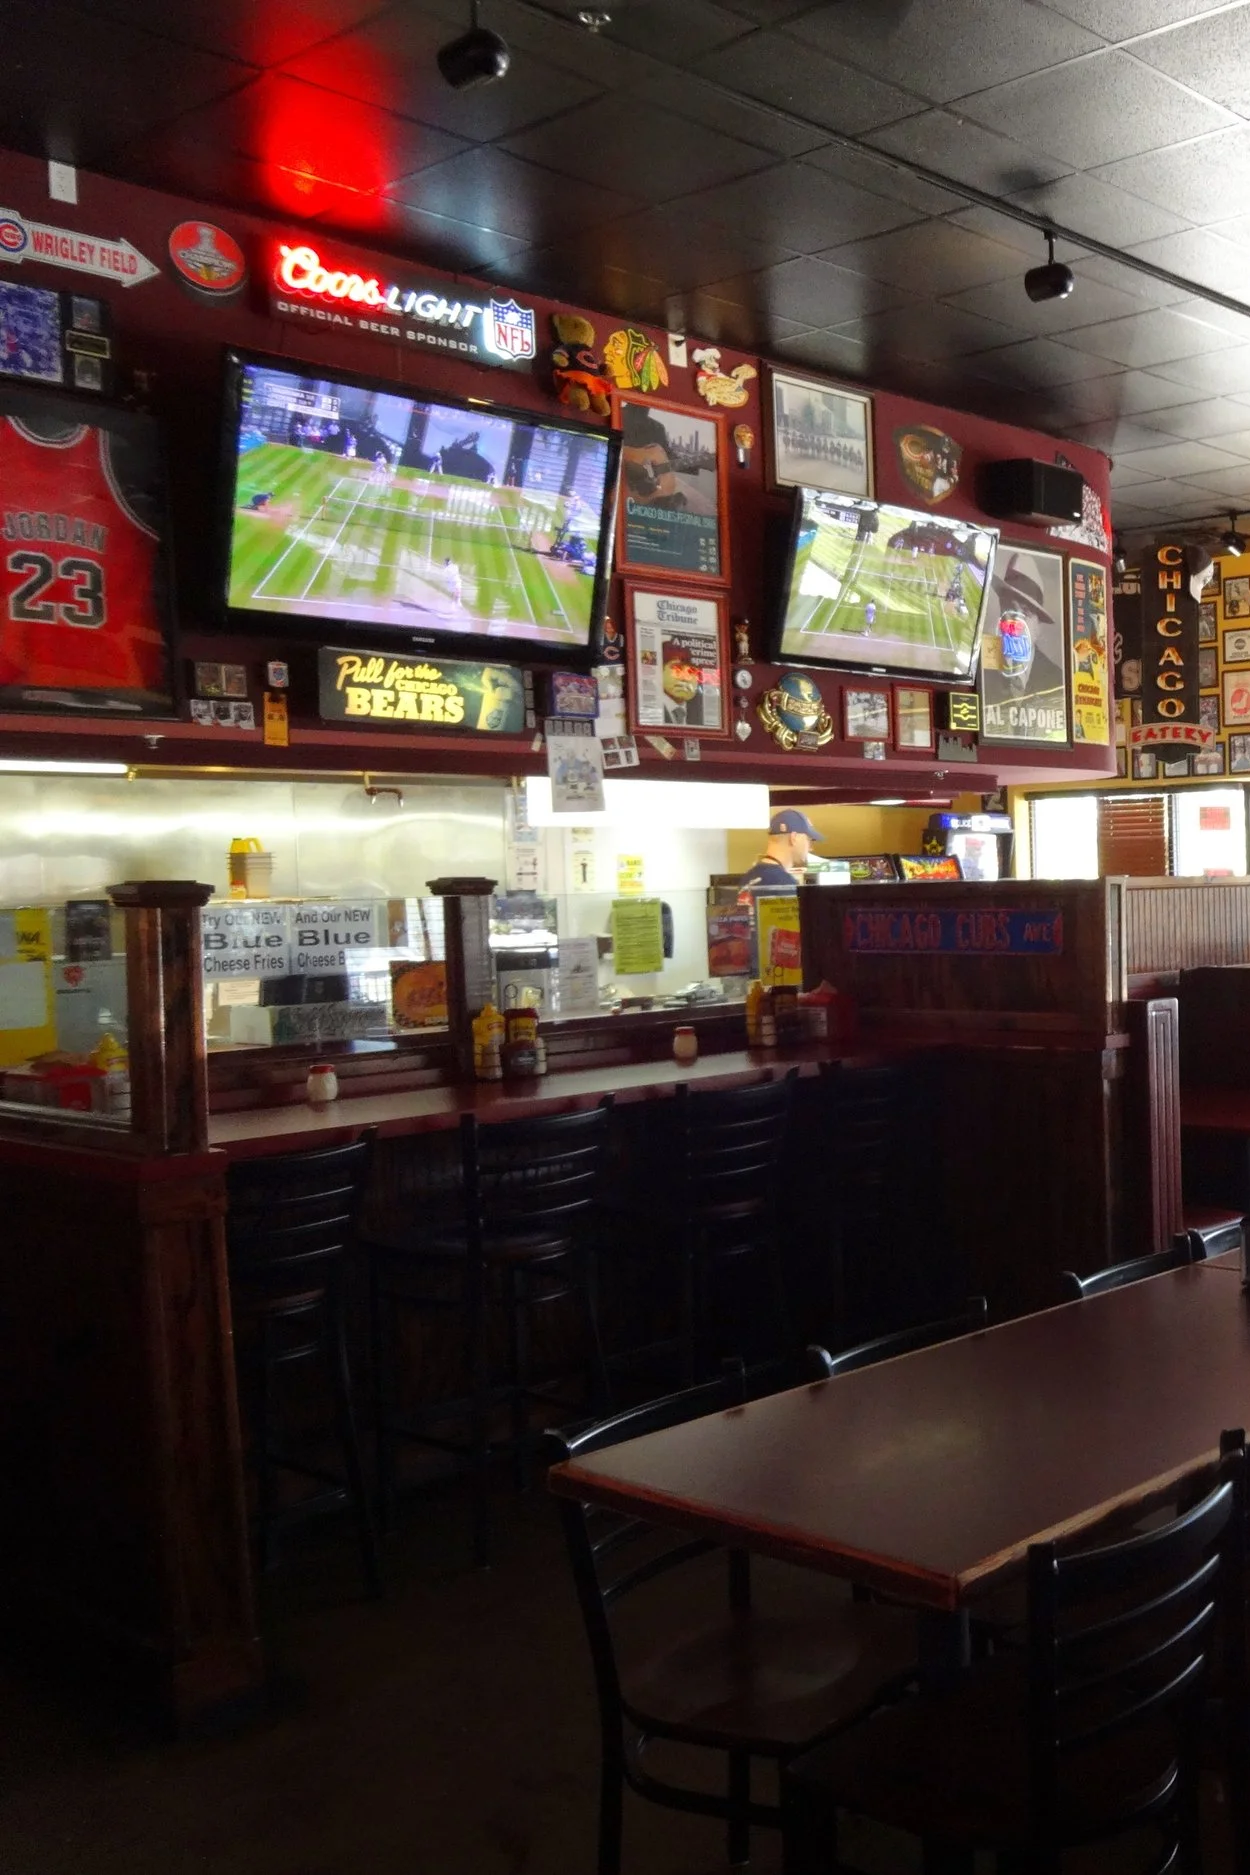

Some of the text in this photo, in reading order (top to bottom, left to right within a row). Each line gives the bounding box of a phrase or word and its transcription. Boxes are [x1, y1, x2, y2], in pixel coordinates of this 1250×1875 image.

[31, 231, 138, 275] WRIGLEY FIELD
[279, 245, 383, 306] Coors
[386, 287, 484, 327] LIGHT
[277, 301, 479, 354] OFFICIAL BEER SPONSOR
[496, 322, 532, 353] NFL
[4, 511, 107, 552] JORDAN
[7, 551, 107, 629] 23
[657, 600, 698, 615] Chicago
[657, 611, 699, 624] Tribune
[1156, 545, 1185, 718] CHICAGO
[672, 637, 717, 649] A political
[336, 656, 442, 691] Pull for the
[395, 680, 458, 695] CHICAGO
[344, 686, 465, 723] BEARS
[986, 706, 1066, 729] AL CAPONE
[1131, 726, 1213, 744] EATERY
[202, 913, 221, 929] Try
[296, 909, 371, 924] And Our NEW
[203, 932, 284, 950] Blue
[297, 929, 371, 947] Blue
[856, 913, 942, 949] CHICAGO
[957, 913, 1011, 949] CUBS
[203, 954, 285, 973] Cheese Fries
[297, 952, 335, 968] Cheese
